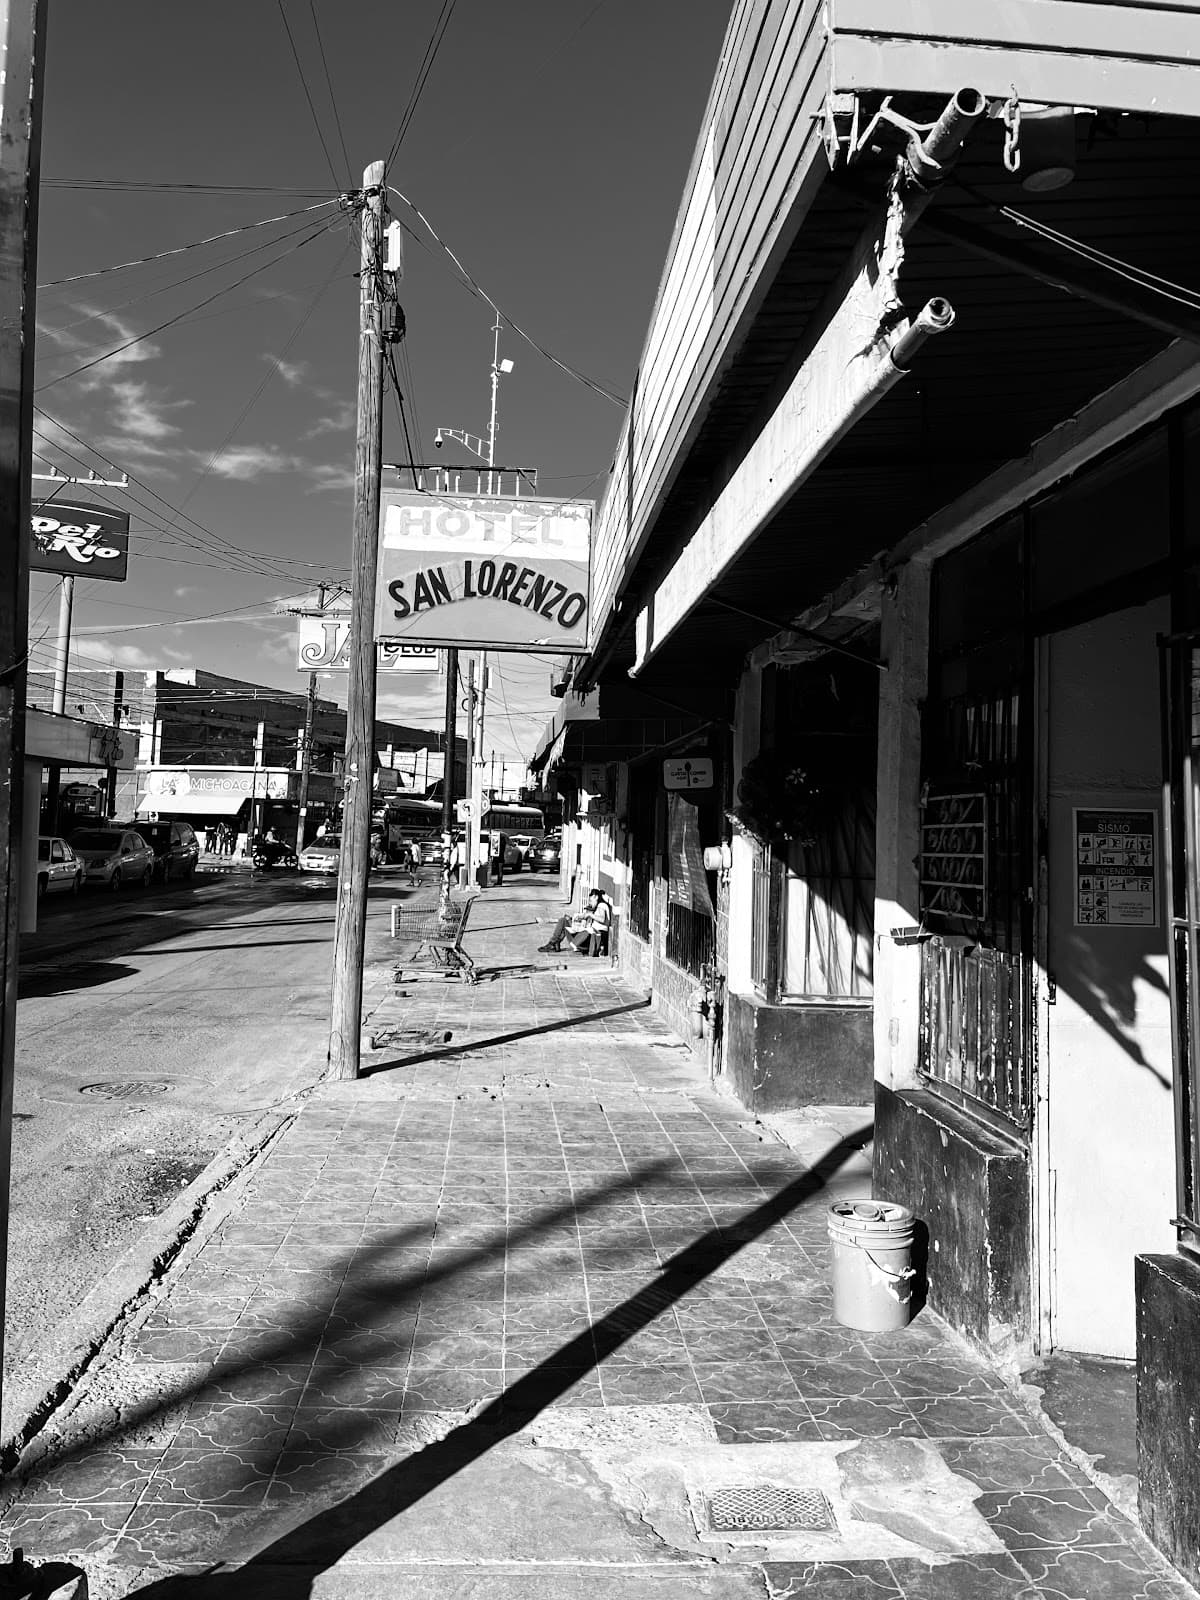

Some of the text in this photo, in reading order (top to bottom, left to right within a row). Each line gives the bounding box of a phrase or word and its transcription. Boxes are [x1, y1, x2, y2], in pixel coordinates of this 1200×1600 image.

[31, 516, 102, 538] Del
[400, 508, 564, 546] HOTEL
[388, 560, 586, 628] SAN LORENZO
[191, 777, 277, 791] MICHOACANA
[1097, 823, 1131, 833] SISMO
[1095, 867, 1136, 876] INCENDIO
